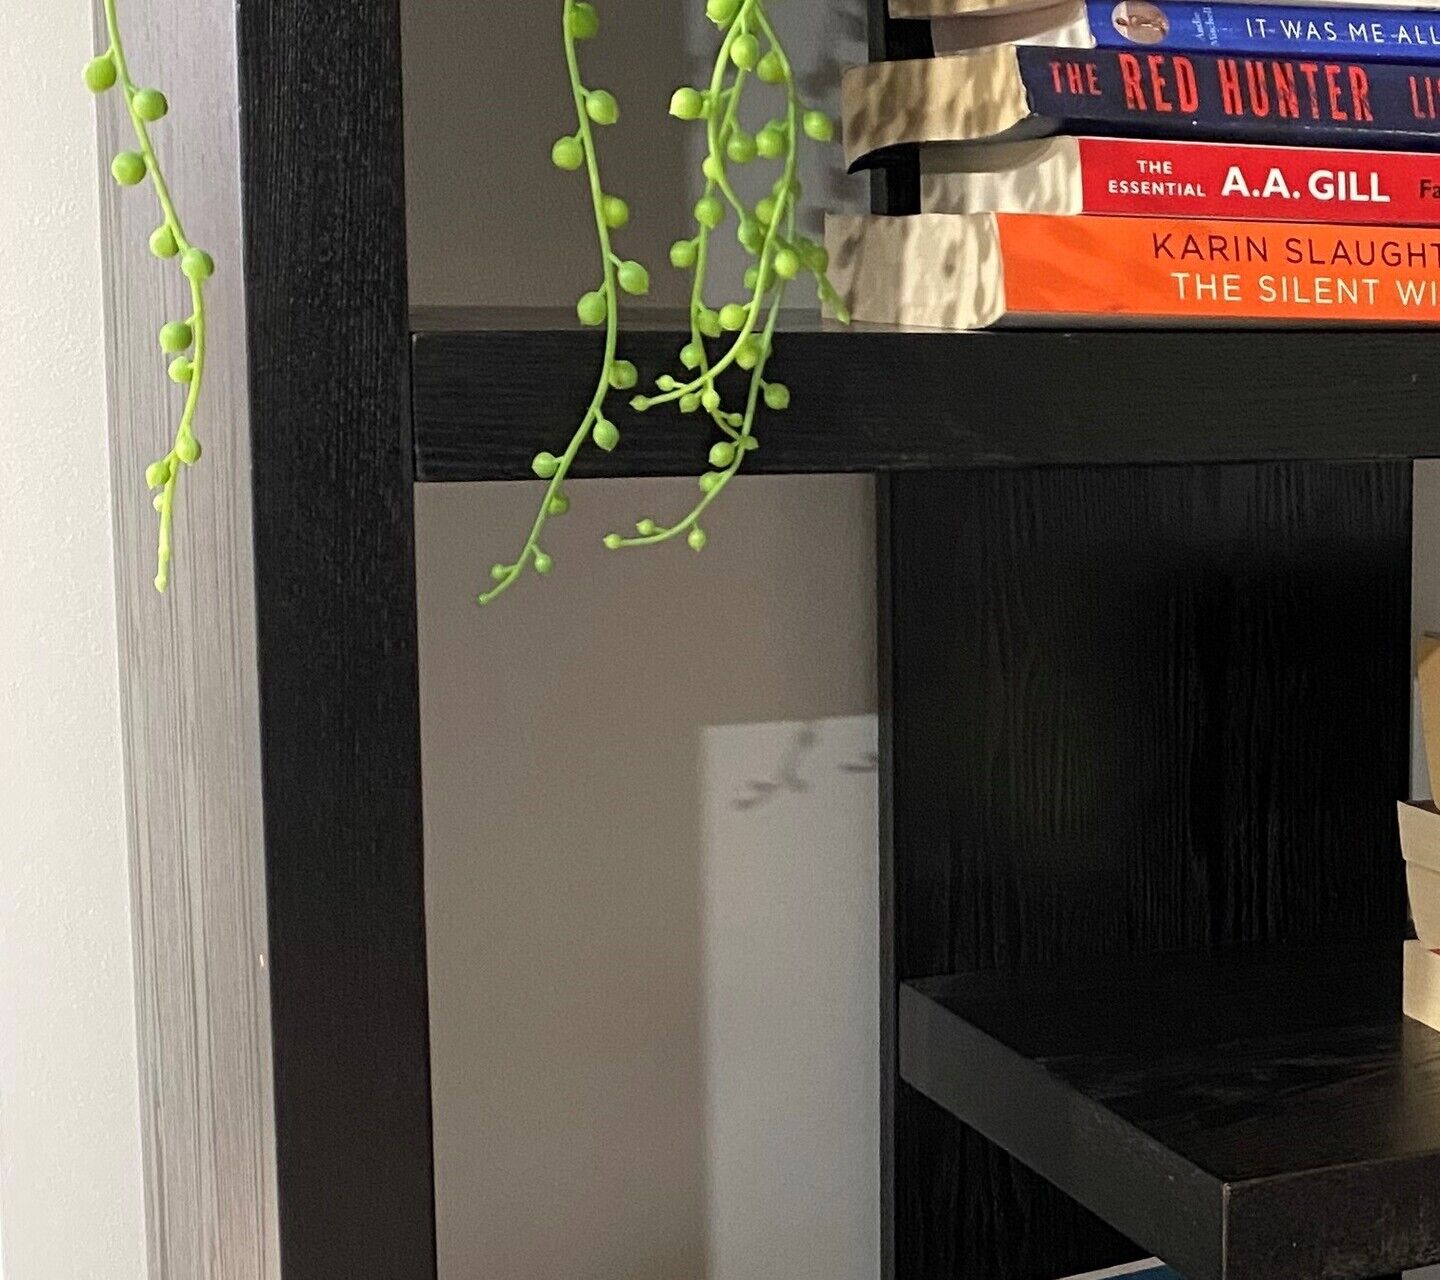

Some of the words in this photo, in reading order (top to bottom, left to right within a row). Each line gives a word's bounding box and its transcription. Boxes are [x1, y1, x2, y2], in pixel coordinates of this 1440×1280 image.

[1246, 17, 1266, 38] IT
[1280, 19, 1337, 42] WAS
[1349, 23, 1384, 44] ME
[1050, 60, 1102, 96] THE
[1118, 53, 1199, 114] RED
[1218, 58, 1374, 121] HUNTER
[1136, 159, 1173, 176] THE
[1108, 179, 1206, 199] ESSENTIAL
[1220, 166, 1301, 200] A.A.
[1308, 168, 1391, 204] GILL
[1153, 232, 1268, 263] KARIN
[1171, 272, 1241, 303] THE
[1257, 274, 1380, 306] SILENT
